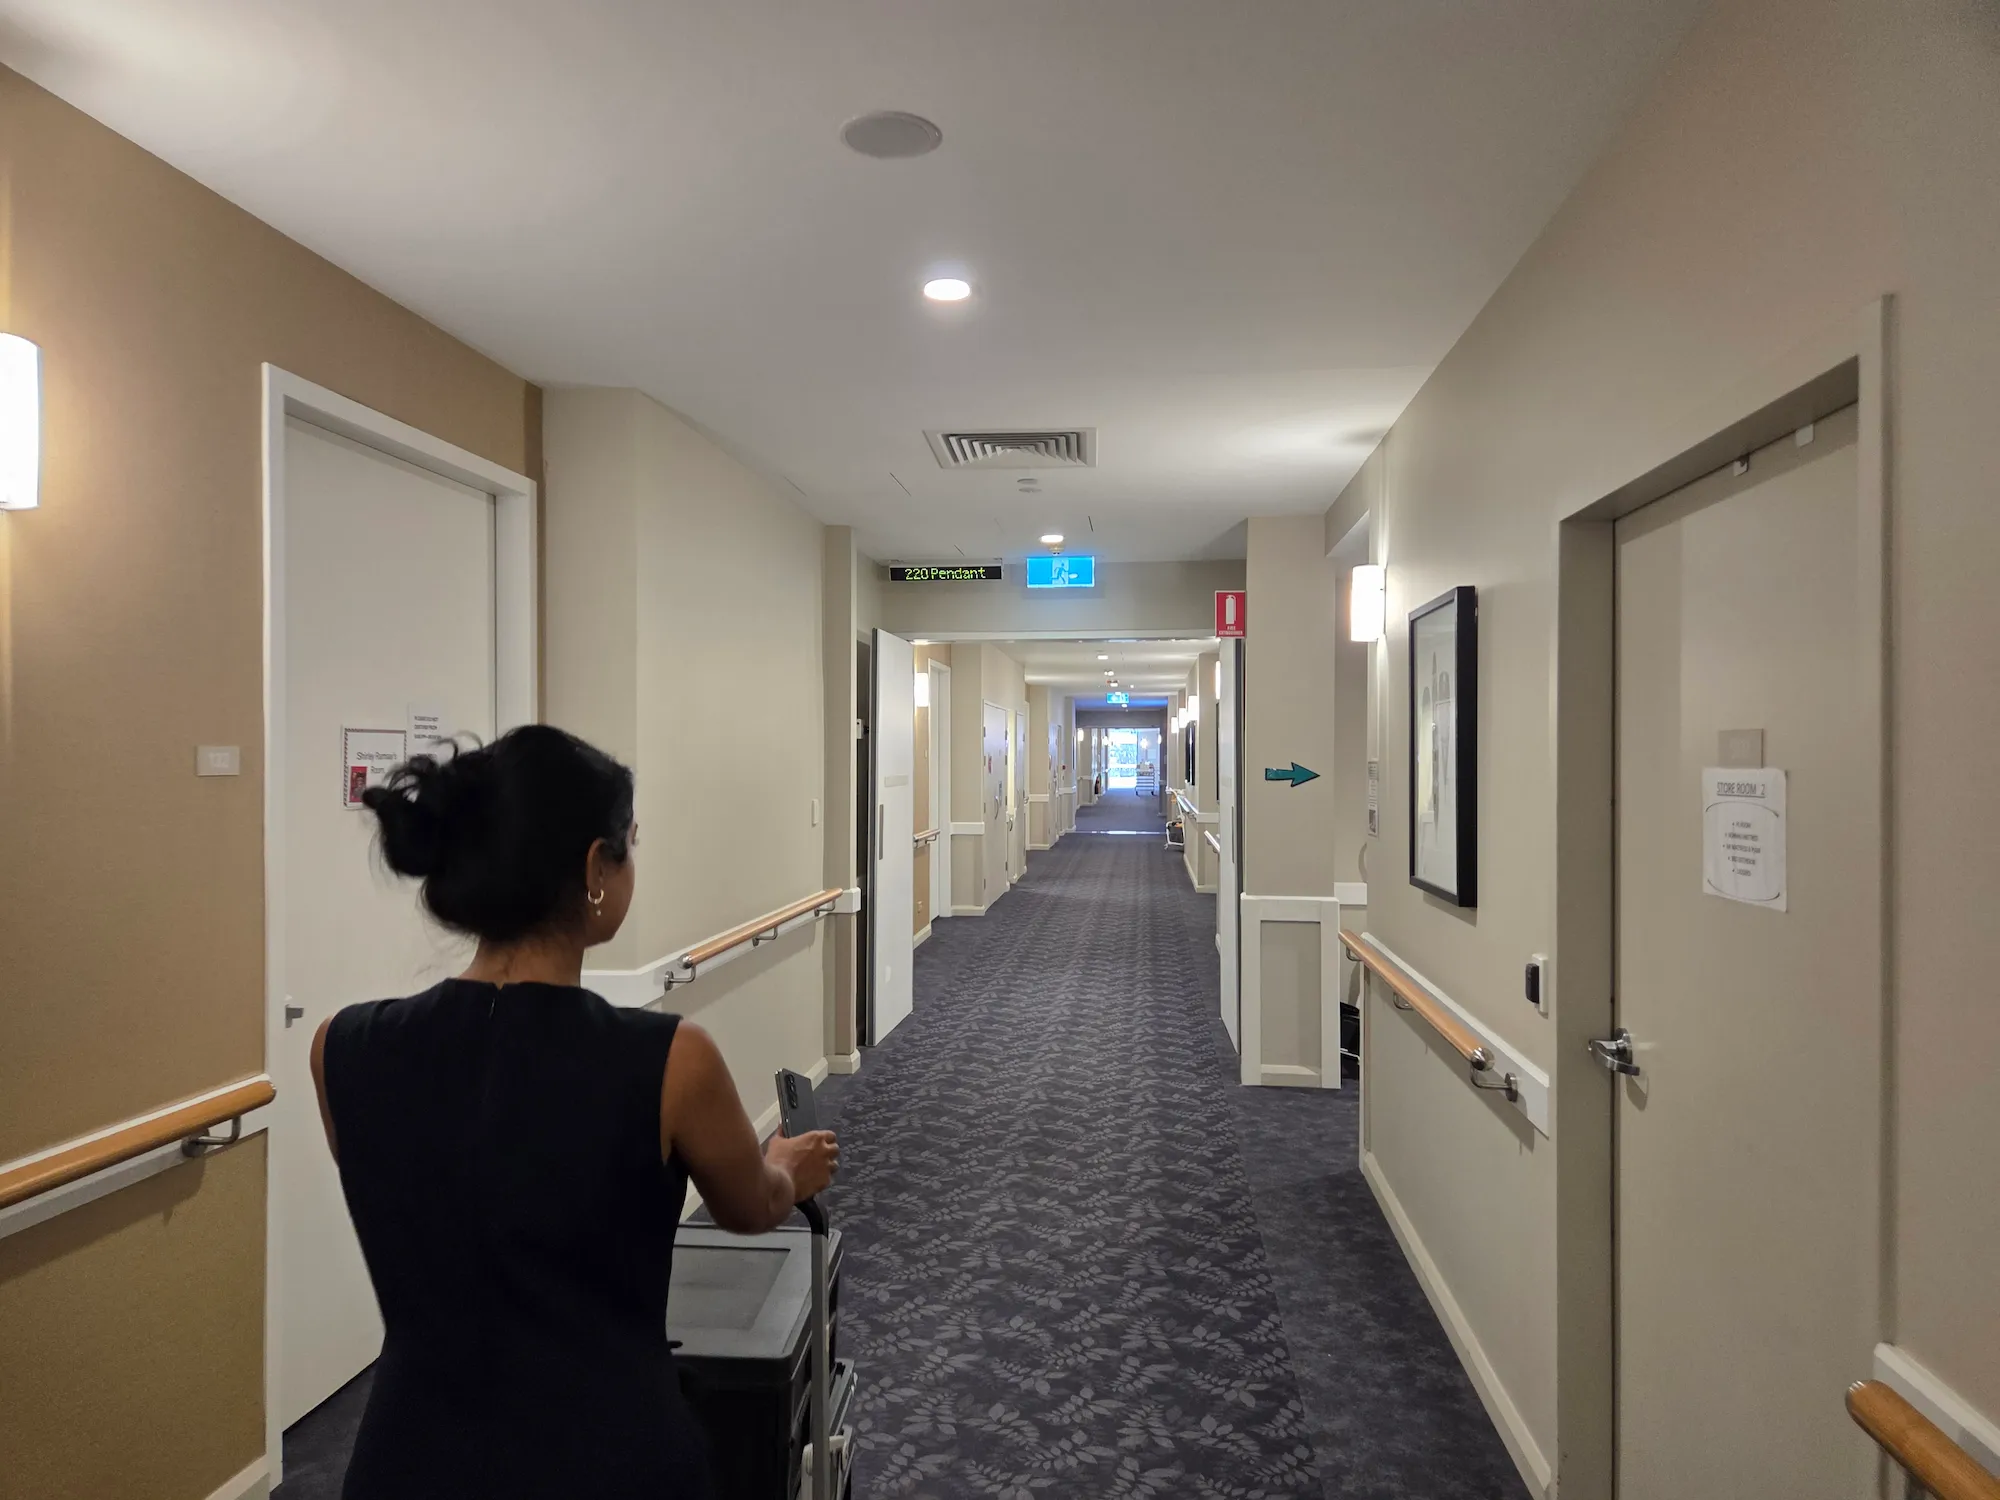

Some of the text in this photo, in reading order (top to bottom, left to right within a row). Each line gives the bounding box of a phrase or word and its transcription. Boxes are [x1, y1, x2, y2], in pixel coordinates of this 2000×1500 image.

[904, 567, 986, 580] 220 Pendant
[1717, 782, 1735, 794] STORE
[1736, 782, 1757, 795] ROOM
